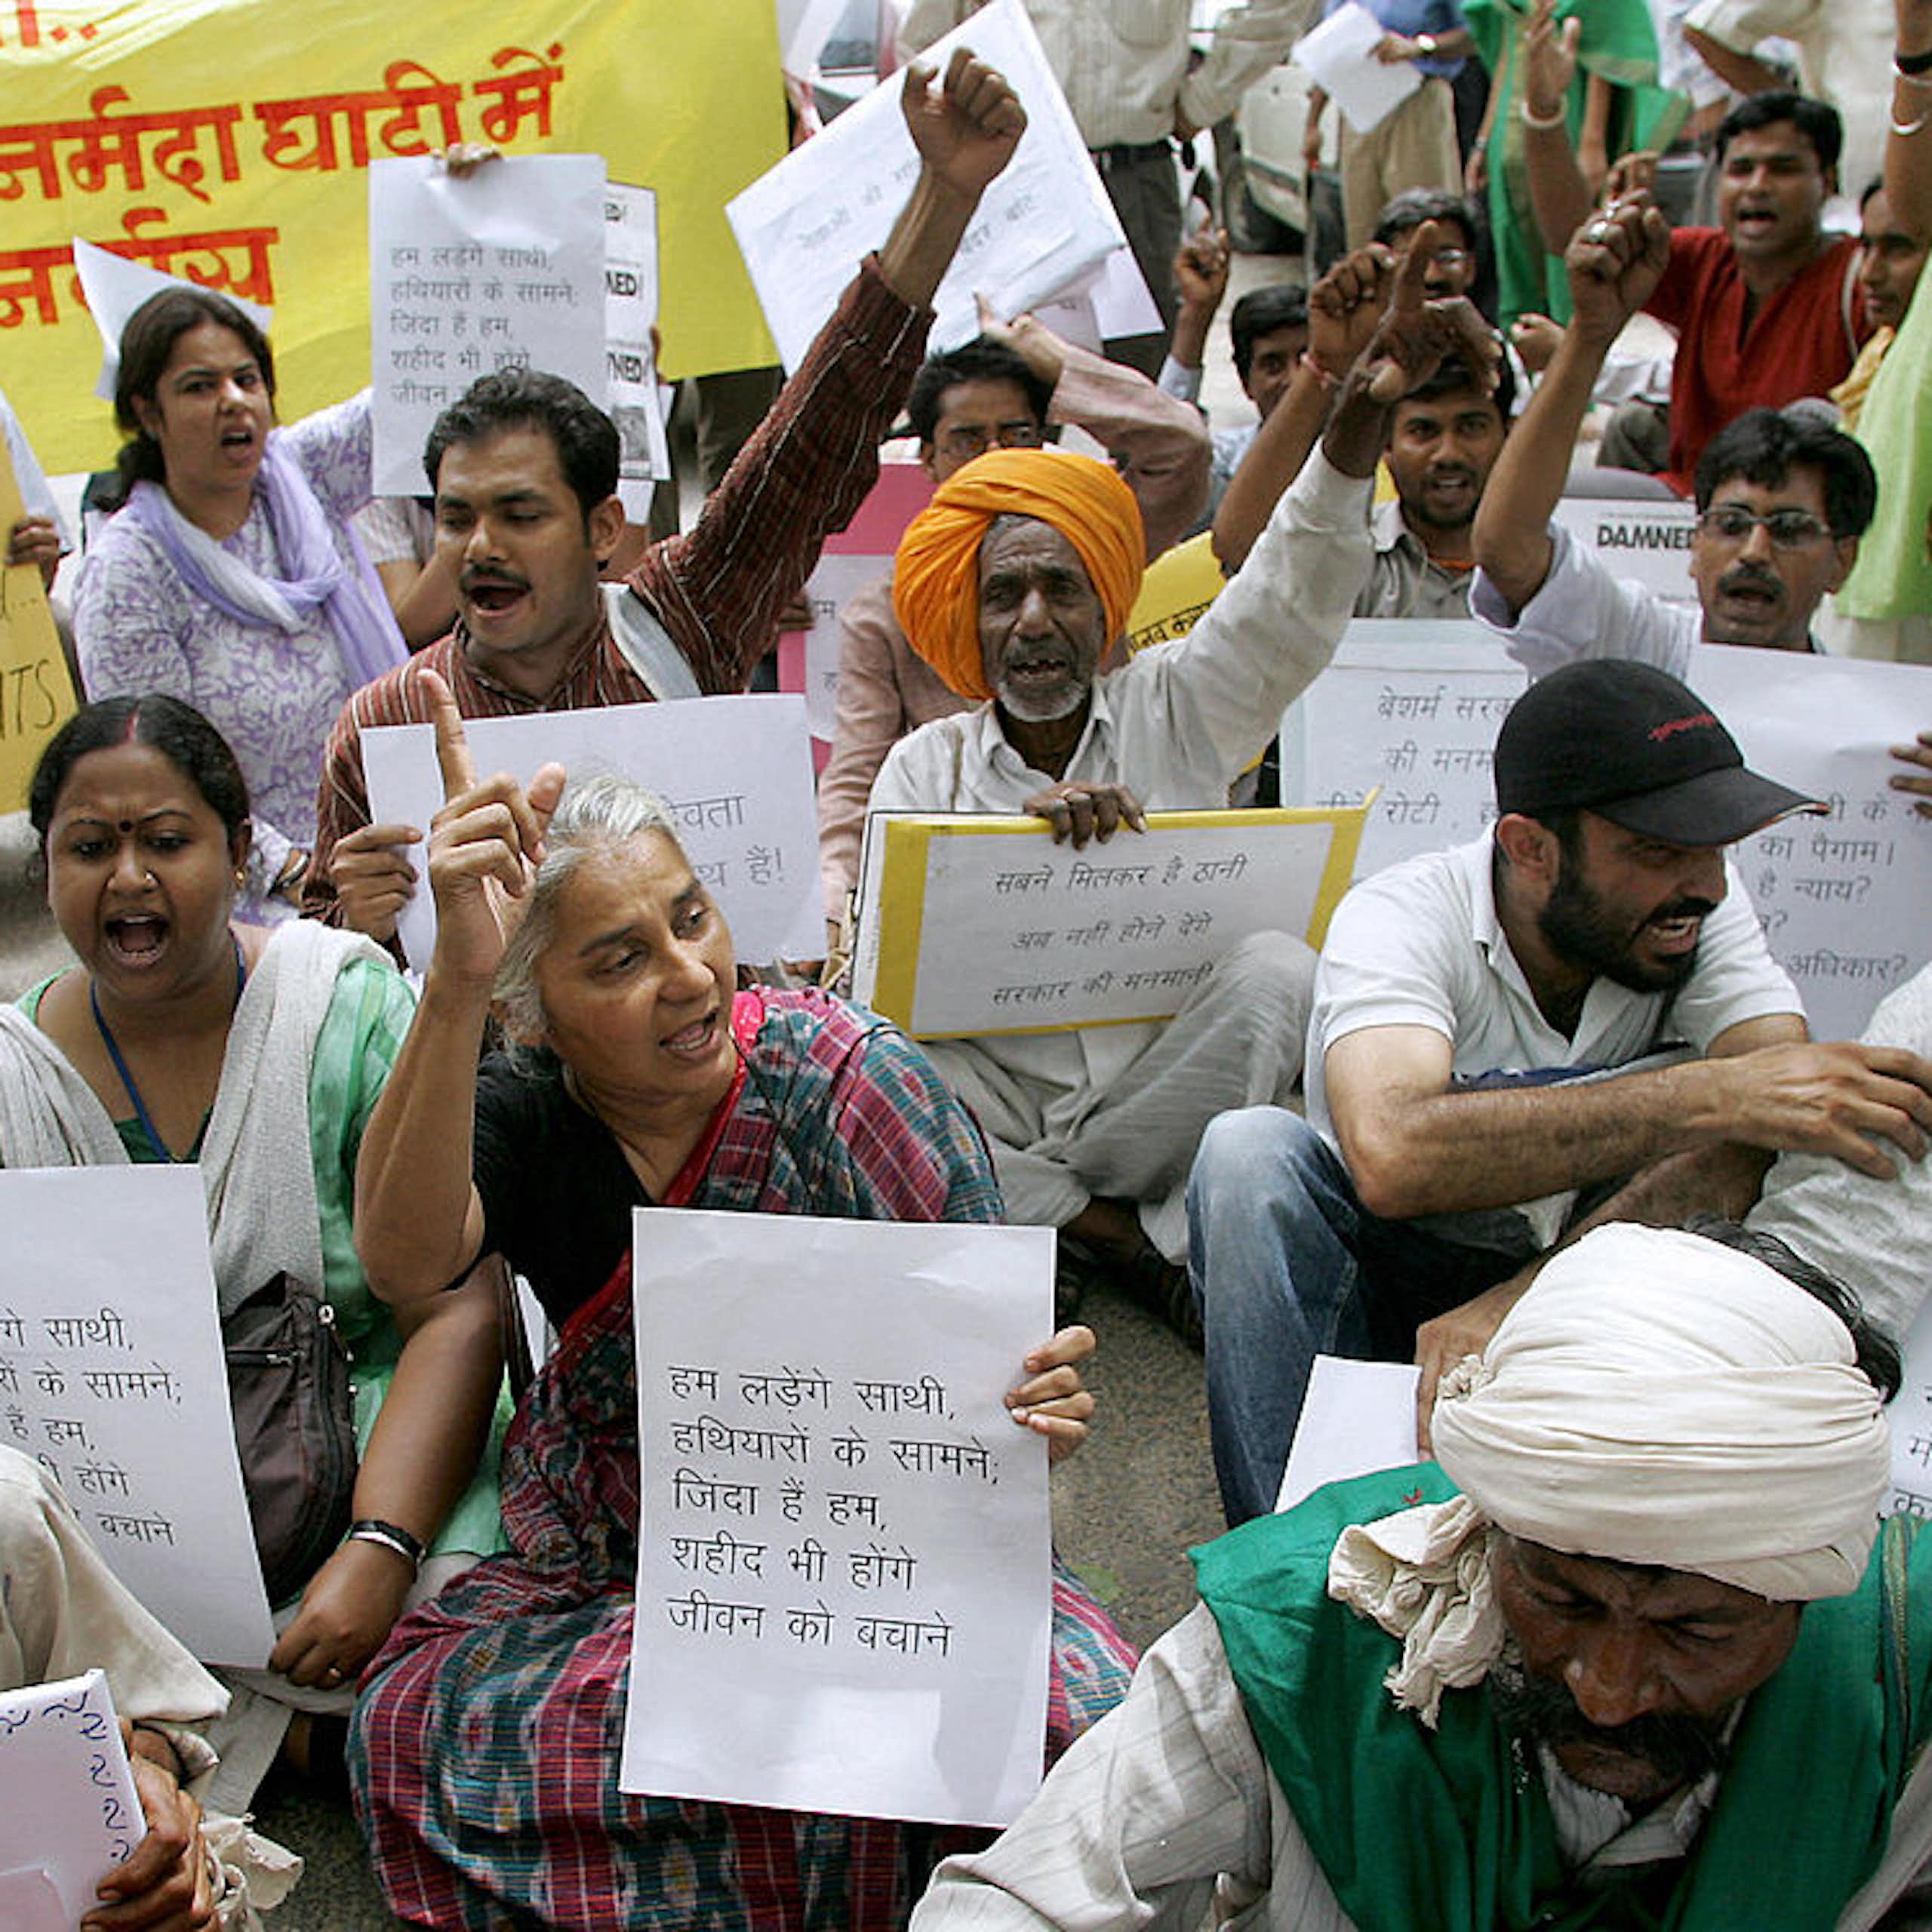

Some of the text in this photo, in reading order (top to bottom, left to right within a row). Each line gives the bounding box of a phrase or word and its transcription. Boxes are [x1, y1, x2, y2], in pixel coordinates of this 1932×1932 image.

[253, 60, 462, 172] घाटी
[472, 42, 565, 143] में
[390, 248, 419, 267] हम
[482, 277, 503, 301] के
[390, 345, 446, 372] शहीद
[457, 343, 482, 370] भी
[389, 378, 448, 405] जीवन
[1377, 685, 1447, 719] बेशर्म
[1382, 739, 1494, 774] की मनम
[1862, 793, 1890, 821] के
[1758, 835, 1795, 862] का
[995, 852, 1249, 894] सबने मिलकर है ठानी
[1758, 868, 1777, 900] है
[1011, 931, 1056, 950] अब
[1118, 914, 1167, 944] होने
[993, 960, 1214, 1006] सरकार की मनमानी
[44, 1307, 134, 1352] साथी,
[33, 1361, 66, 1397] के
[82, 1360, 182, 1405] सामने;
[669, 1364, 956, 1420] हम लड़ेंगे साथी,
[41, 1417, 97, 1451] हम,
[671, 1414, 1000, 1485] हथियारों के सामने;
[74, 1459, 130, 1497] होंगे
[672, 1466, 888, 1532] जिंदा हैं हम,
[670, 1530, 917, 1591] शहीद भी होंगे
[667, 1589, 953, 1657] जीवन को बचाने
